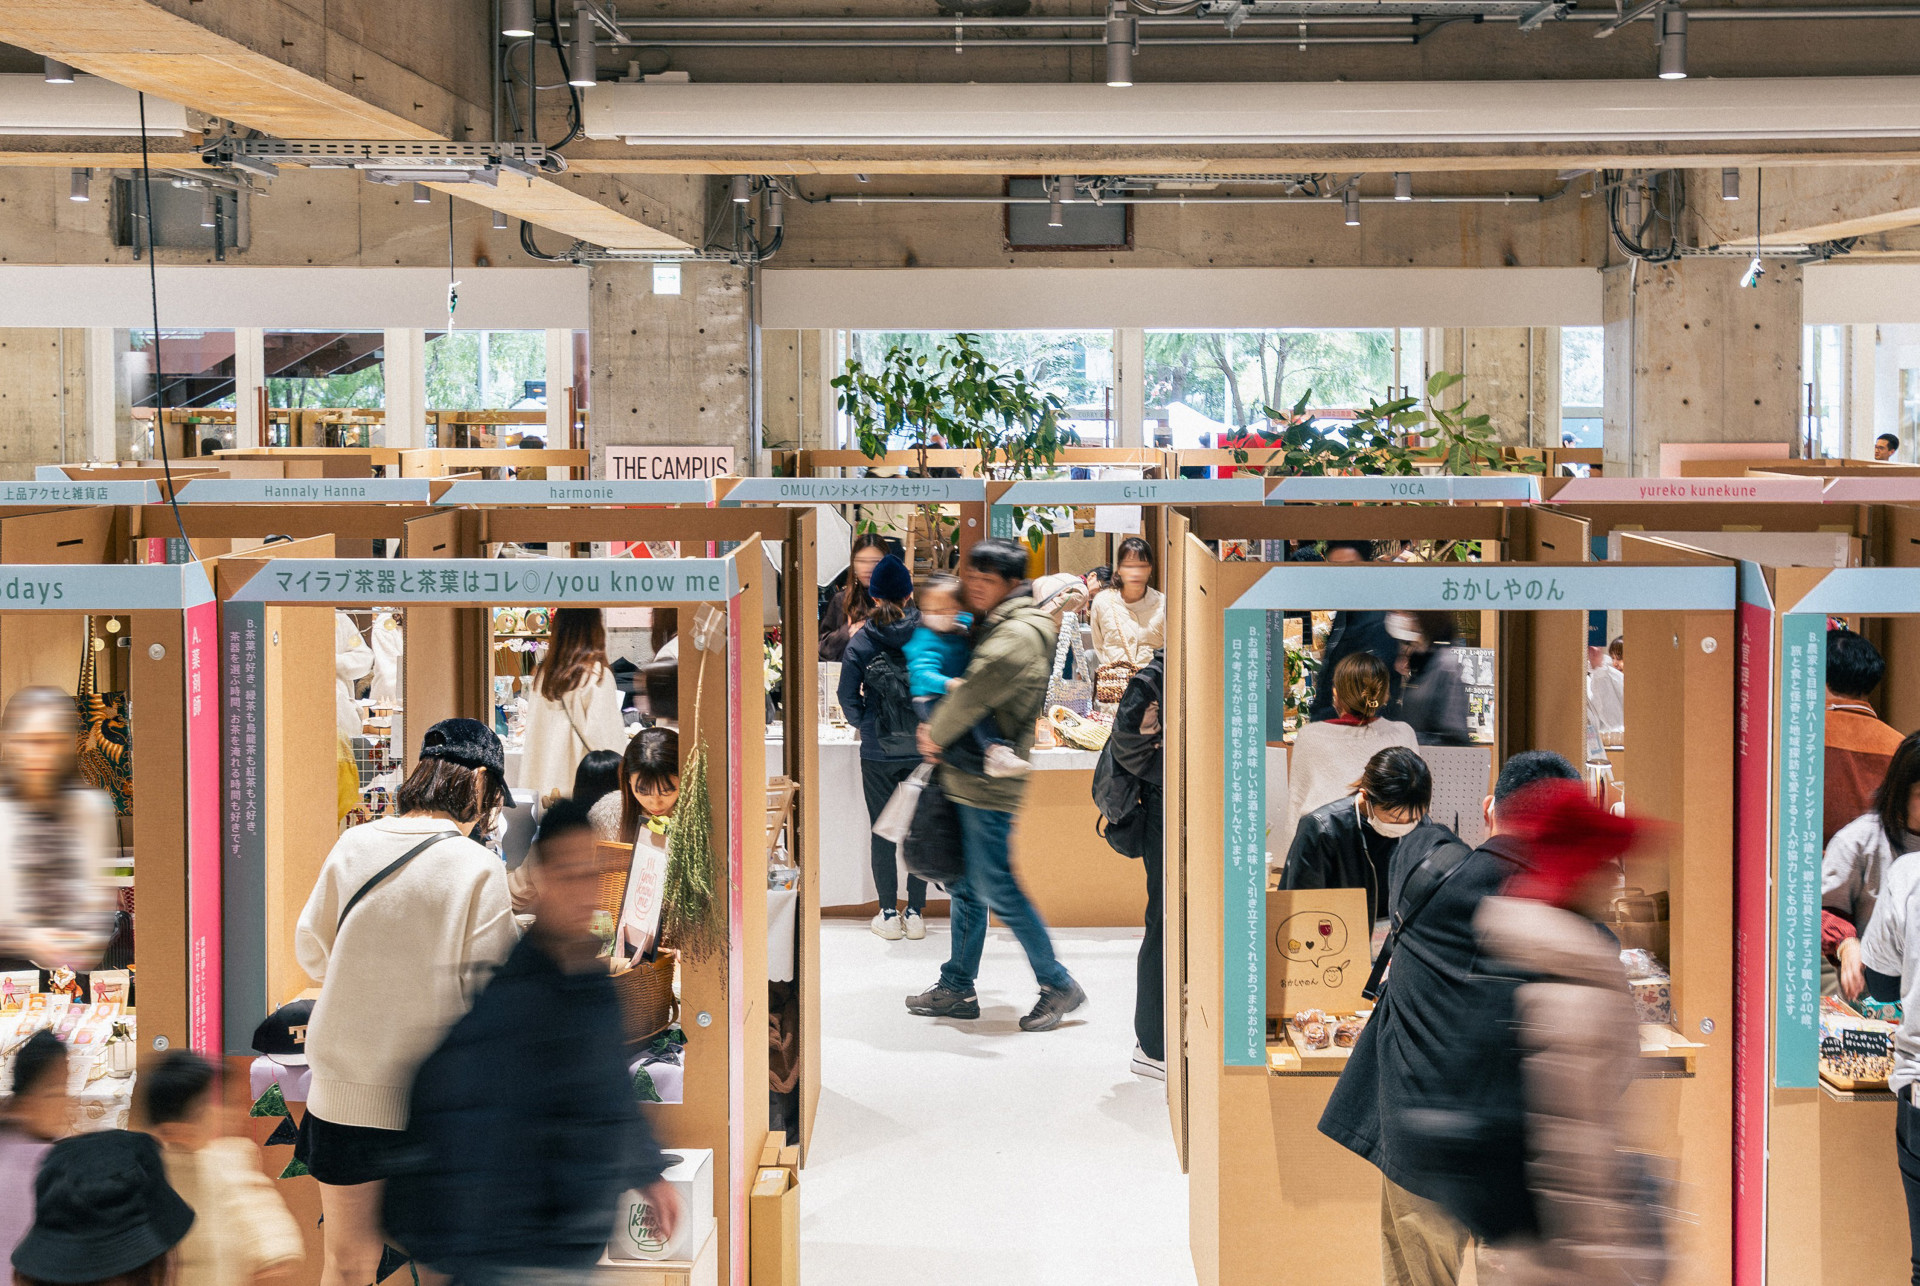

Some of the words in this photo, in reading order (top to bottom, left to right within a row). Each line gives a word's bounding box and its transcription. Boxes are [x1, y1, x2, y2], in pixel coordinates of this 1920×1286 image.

[613, 456, 647, 480] THE
[651, 456, 728, 480] CAMPUS
[4, 486, 108, 501] 上品アクセと雑貨店
[265, 484, 319, 499] Hannaly
[324, 484, 366, 497] Hanna
[550, 485, 614, 499] harmonie
[1123, 485, 1158, 498] G-LIT
[1390, 483, 1426, 496] YOCA
[1640, 484, 1686, 500] yureko
[1690, 484, 1757, 498] kunekune
[611, 570, 675, 592] know
[686, 574, 720, 592] me
[0, 576, 63, 605] days
[1441, 577, 1565, 601] おかしやのん
